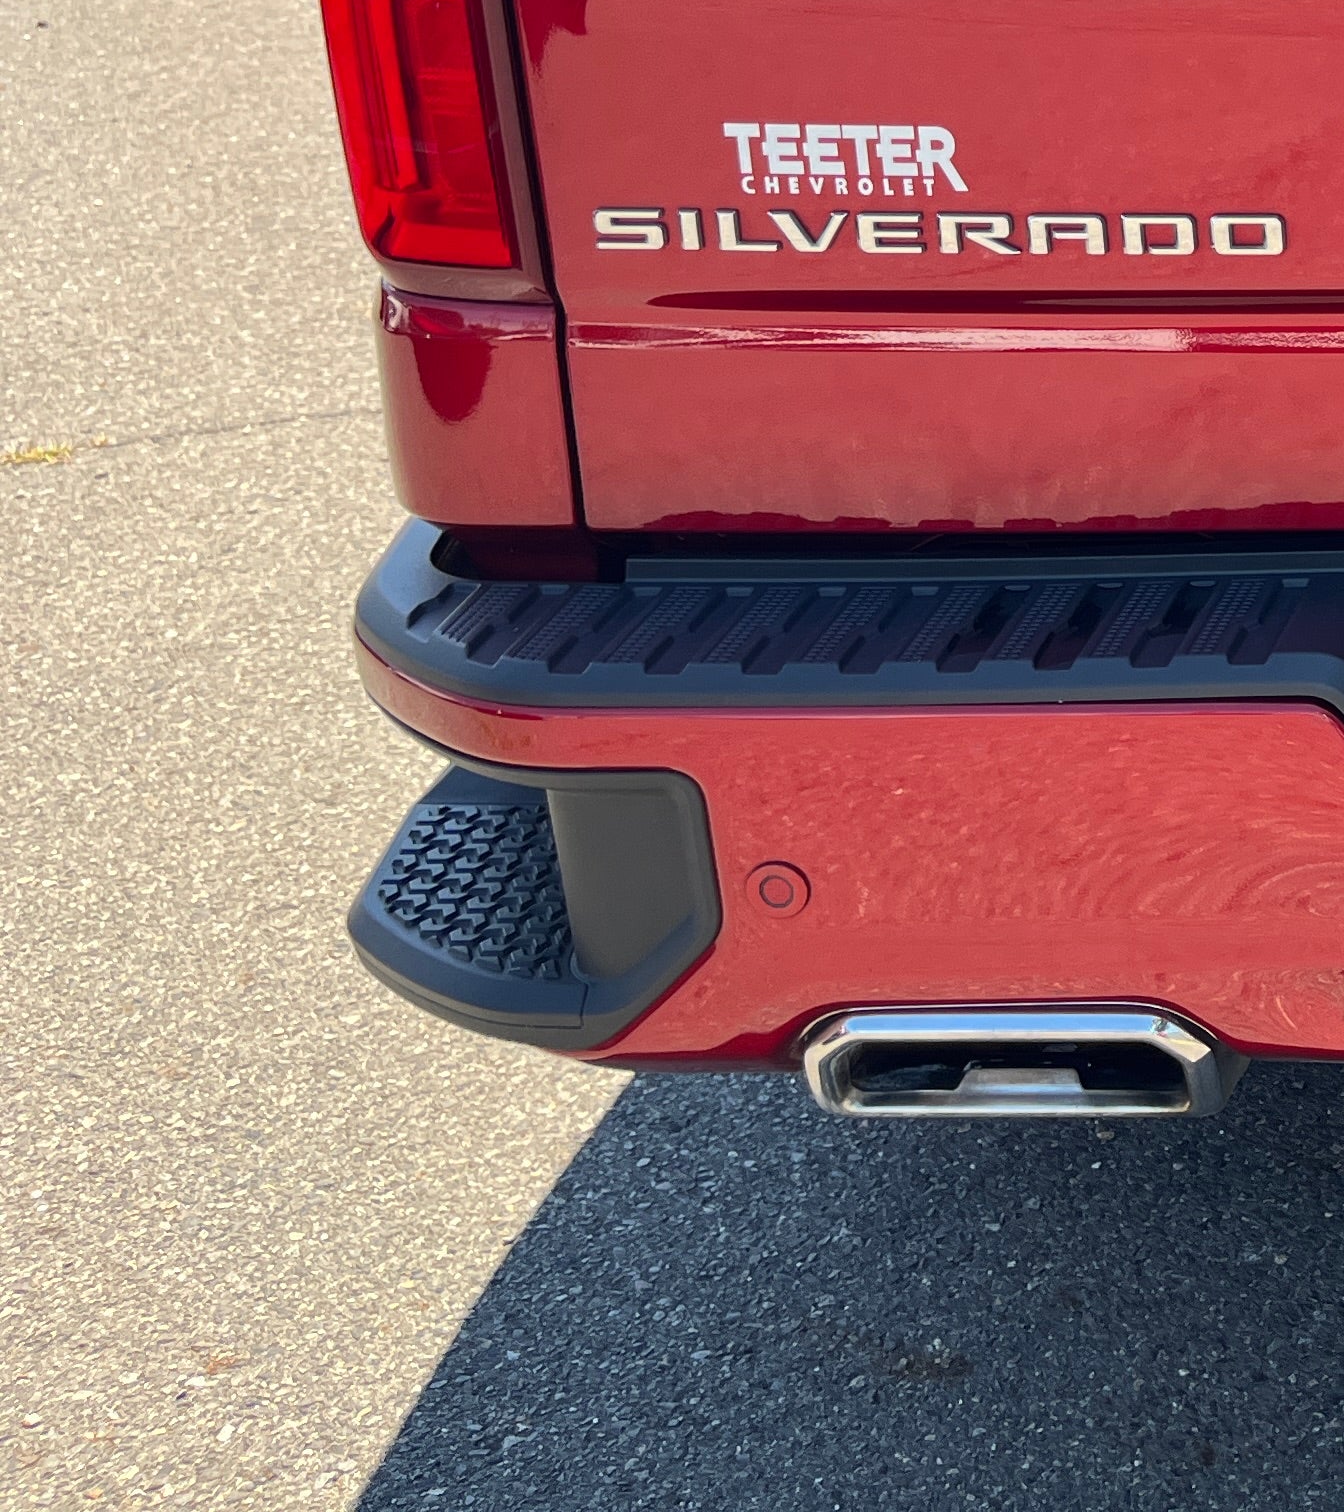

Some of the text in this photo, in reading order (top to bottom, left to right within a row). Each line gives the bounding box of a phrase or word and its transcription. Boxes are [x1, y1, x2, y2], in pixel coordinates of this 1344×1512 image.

[722, 122, 968, 192] TEETER
[741, 175, 938, 197] CHEVROLET
[593, 207, 1287, 257] SILVERADO
